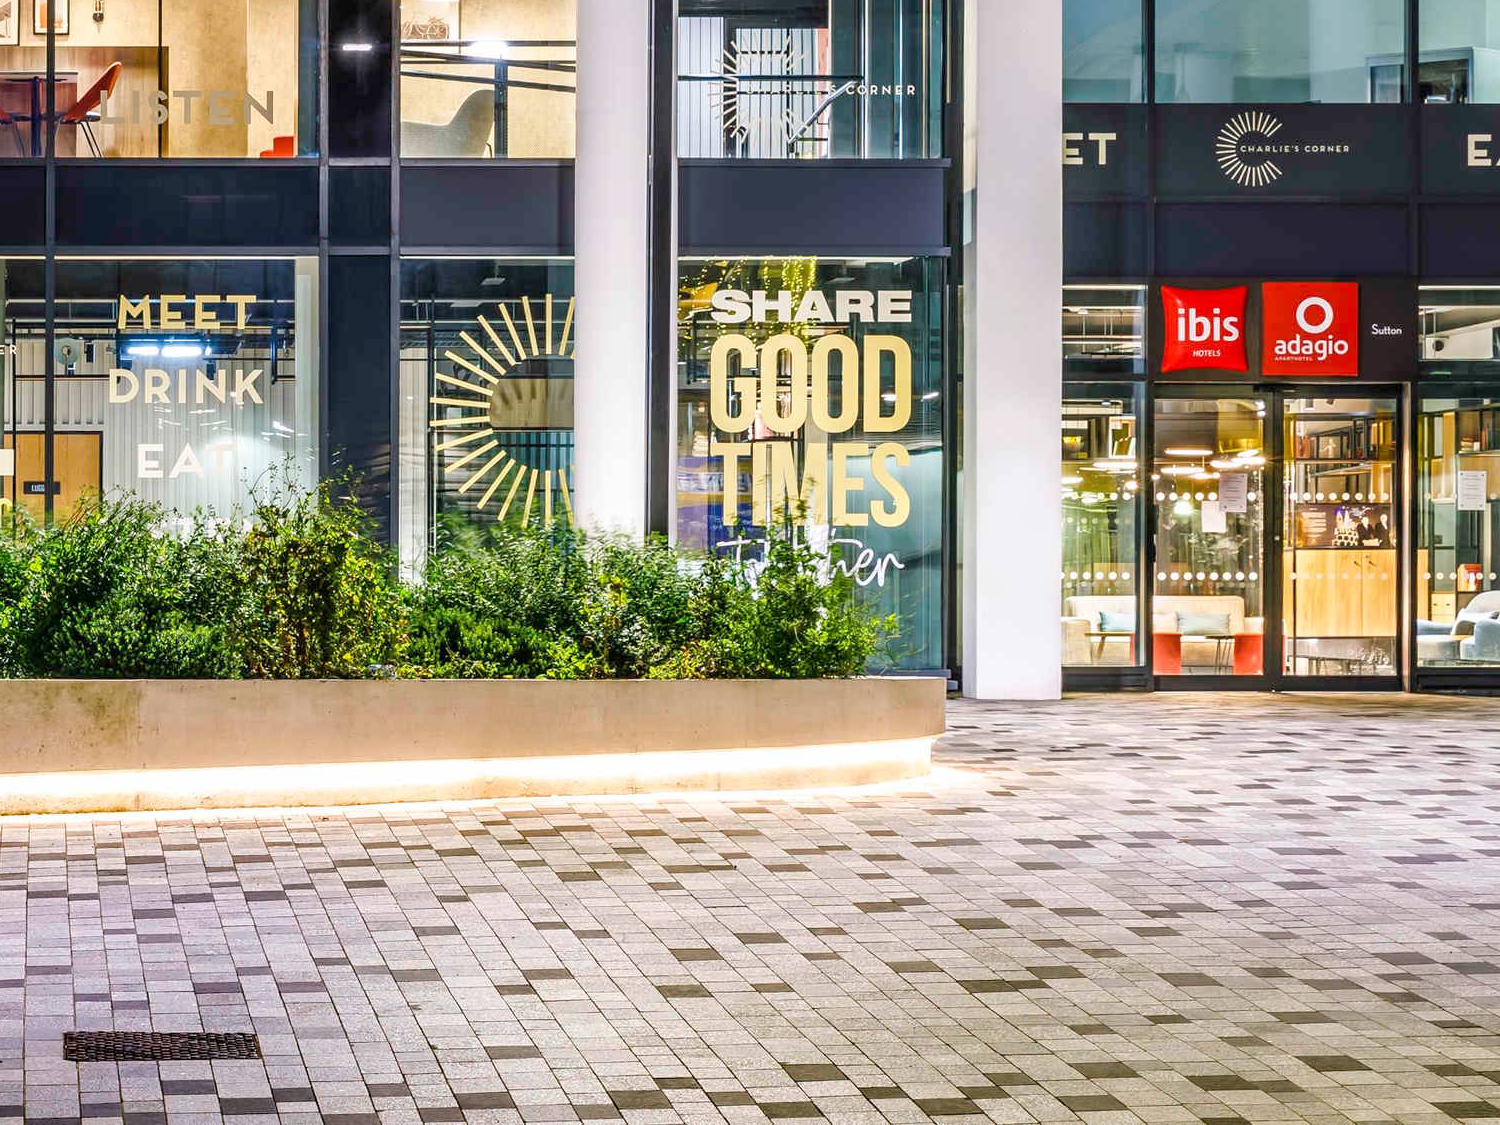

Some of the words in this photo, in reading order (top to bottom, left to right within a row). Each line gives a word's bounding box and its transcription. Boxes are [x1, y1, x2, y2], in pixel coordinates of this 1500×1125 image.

[100, 90, 273, 125] LISTEN
[846, 85, 916, 96] CORNER
[1239, 145, 1300, 153] CHARLIE'S
[1304, 145, 1350, 153] CORNER
[1467, 133, 1500, 166] E
[118, 294, 257, 330] MEET
[710, 289, 912, 323] SHARE
[1177, 307, 1239, 342] ibis
[1371, 324, 1402, 335] Sutton
[1192, 349, 1221, 357] HOTELS
[1274, 334, 1348, 361] adagio
[109, 368, 263, 404] DRINK
[710, 333, 912, 434] GOOD
[137, 442, 237, 479] EAT
[710, 442, 911, 528] TIMES
